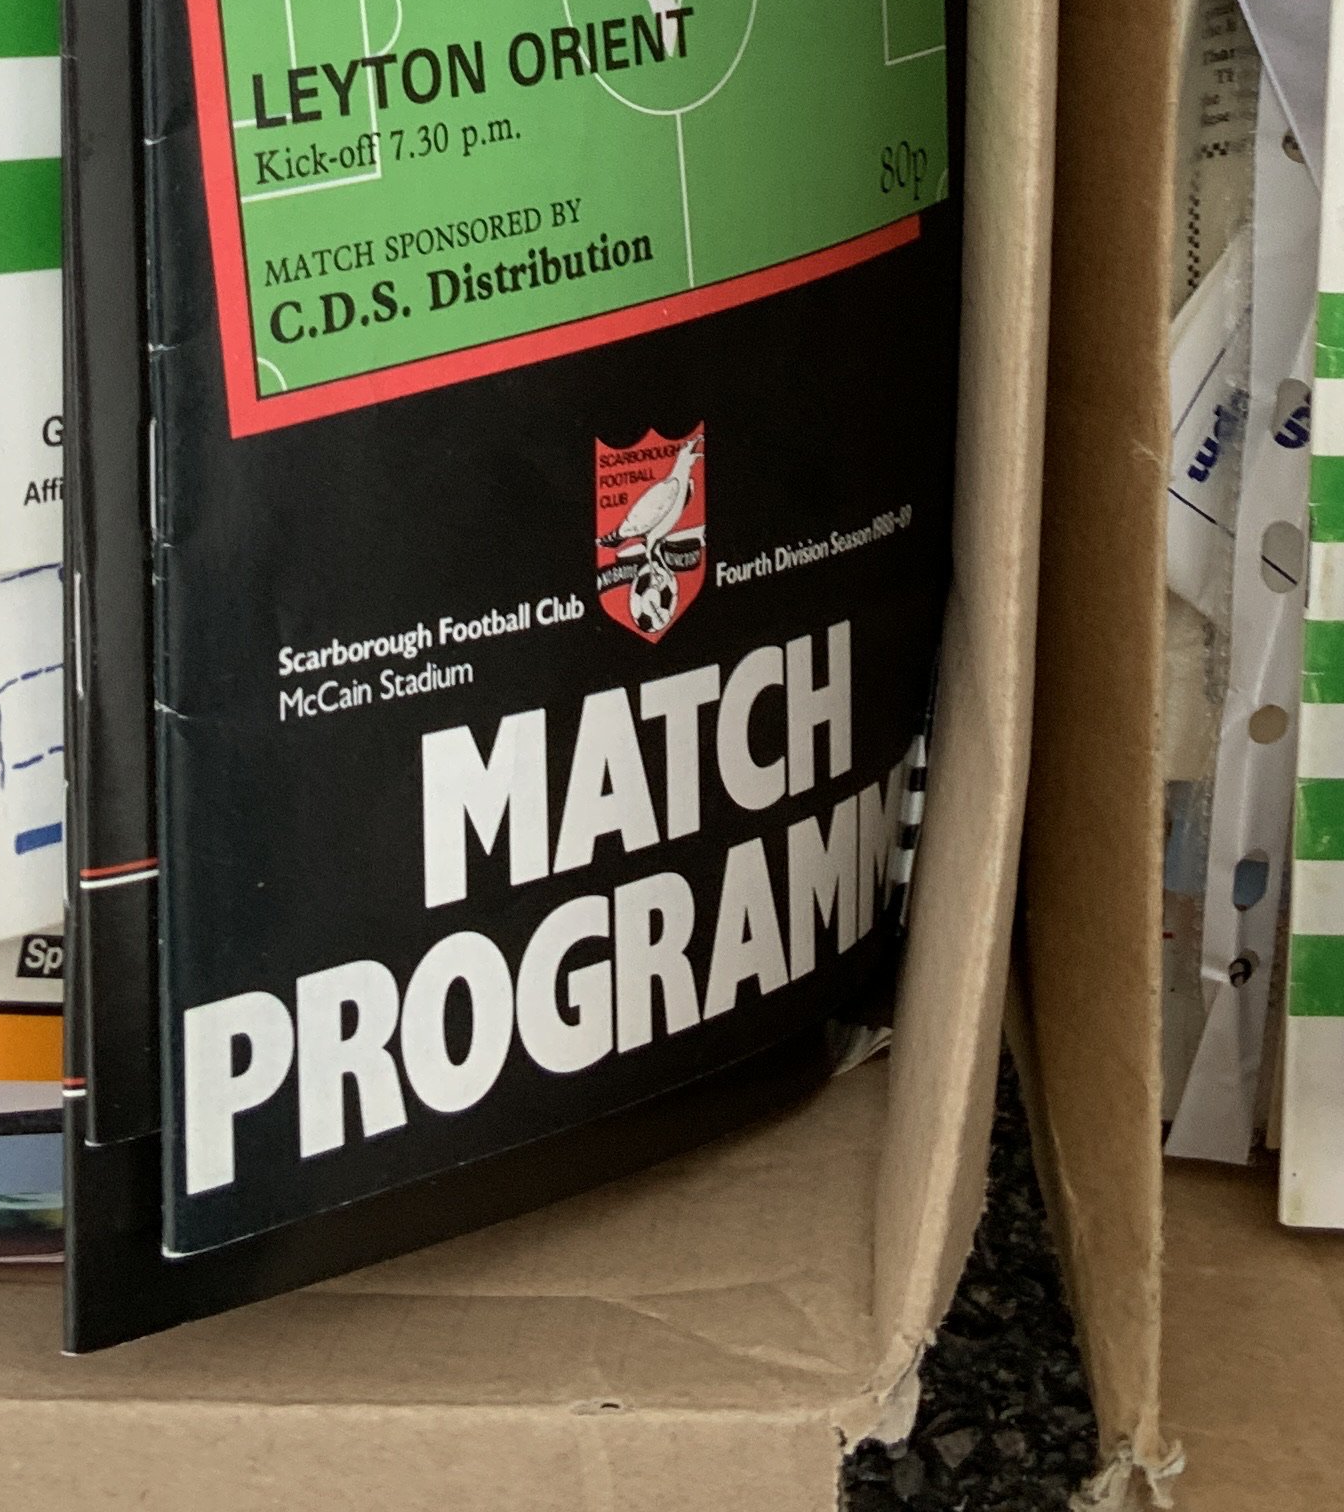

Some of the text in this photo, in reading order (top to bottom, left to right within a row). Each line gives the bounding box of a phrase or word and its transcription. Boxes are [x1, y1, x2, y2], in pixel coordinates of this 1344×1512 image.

[252, 6, 695, 130] LEYTON ORIENT
[255, 114, 522, 185] Kick-off 7.30 p.m.
[880, 141, 928, 201] 80p
[264, 198, 583, 287] MATCH SPONSORED BY
[269, 233, 654, 344] C.D.S. Distribution
[599, 468, 656, 488] FOOTBALL
[599, 492, 629, 509] CLUB
[716, 549, 773, 587] Fourth
[775, 536, 829, 573] Division
[830, 526, 872, 556] Season
[279, 593, 585, 676] Scarborough Football Club
[279, 661, 474, 722] McCain Stadium
[421, 619, 852, 910] MATCH
